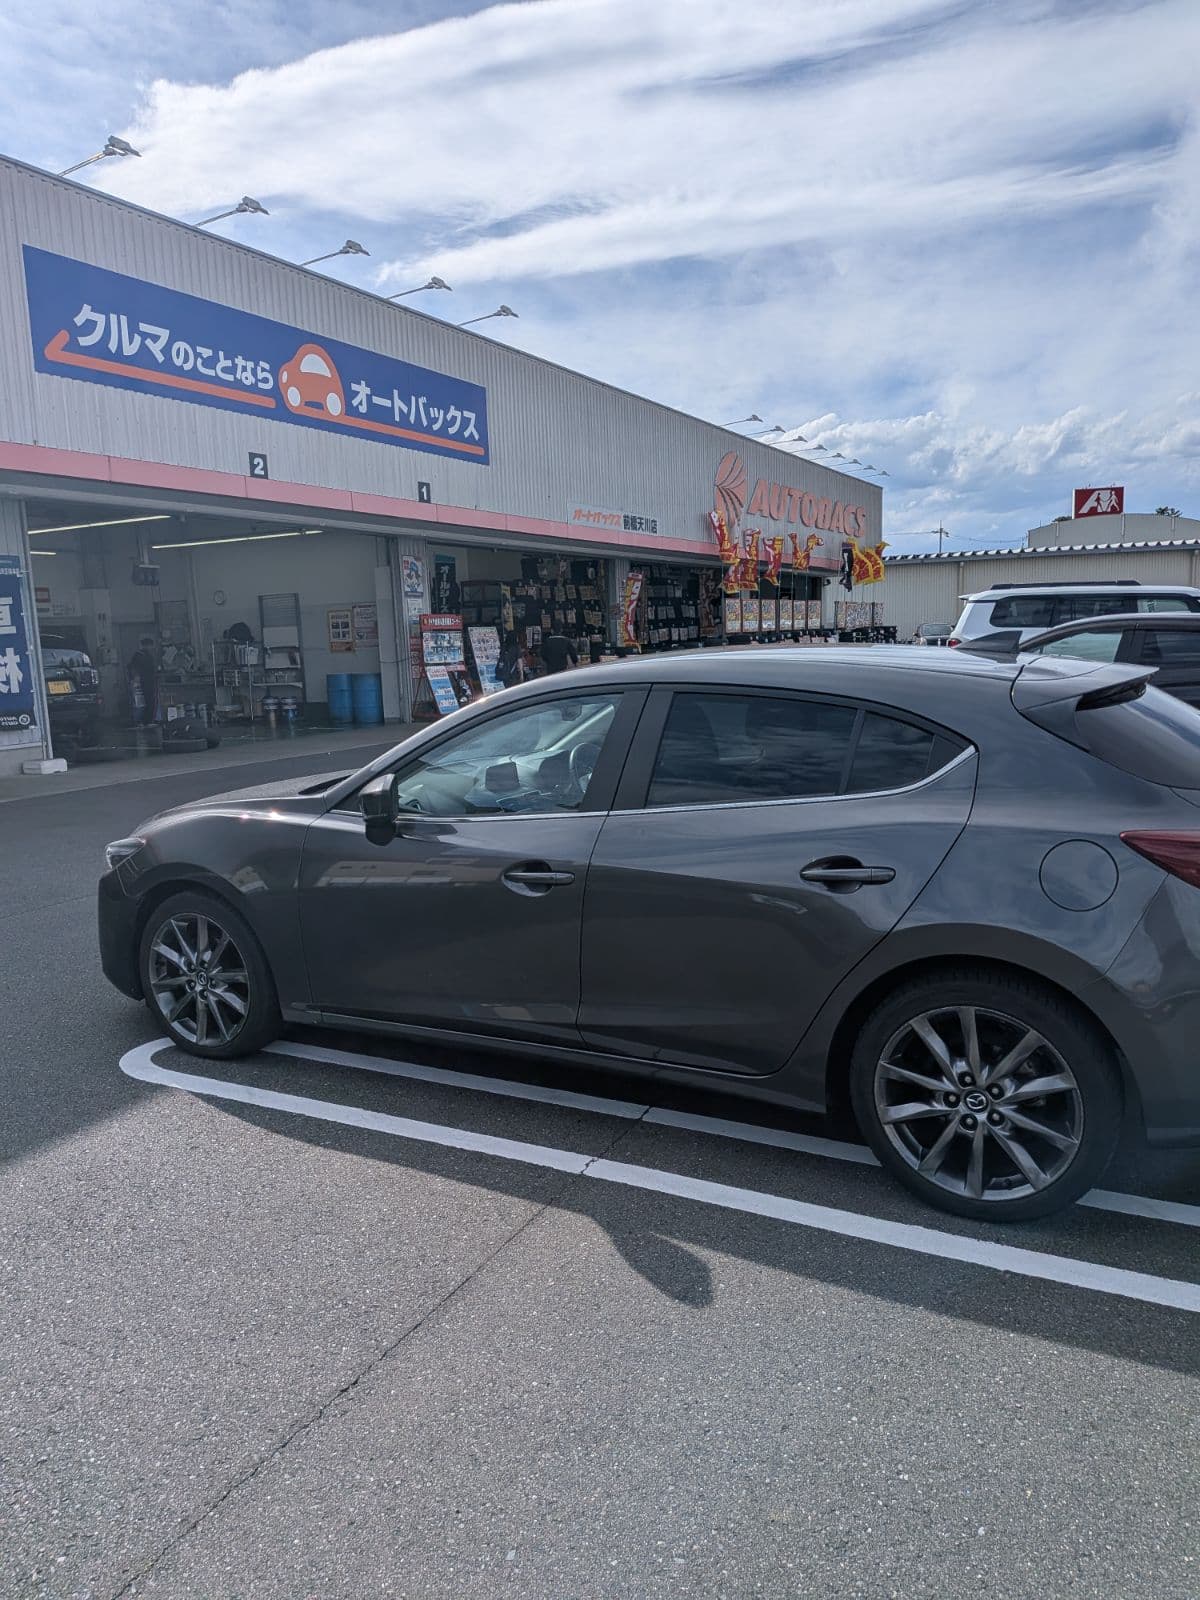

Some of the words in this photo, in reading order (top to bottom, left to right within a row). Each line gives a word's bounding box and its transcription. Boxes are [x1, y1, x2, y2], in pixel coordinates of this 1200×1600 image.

[73, 303, 274, 390] クルマのことなら
[350, 380, 480, 441] オートバックス
[253, 457, 265, 476] 2
[421, 485, 428, 501] 1
[747, 479, 867, 538] AUTOBACS
